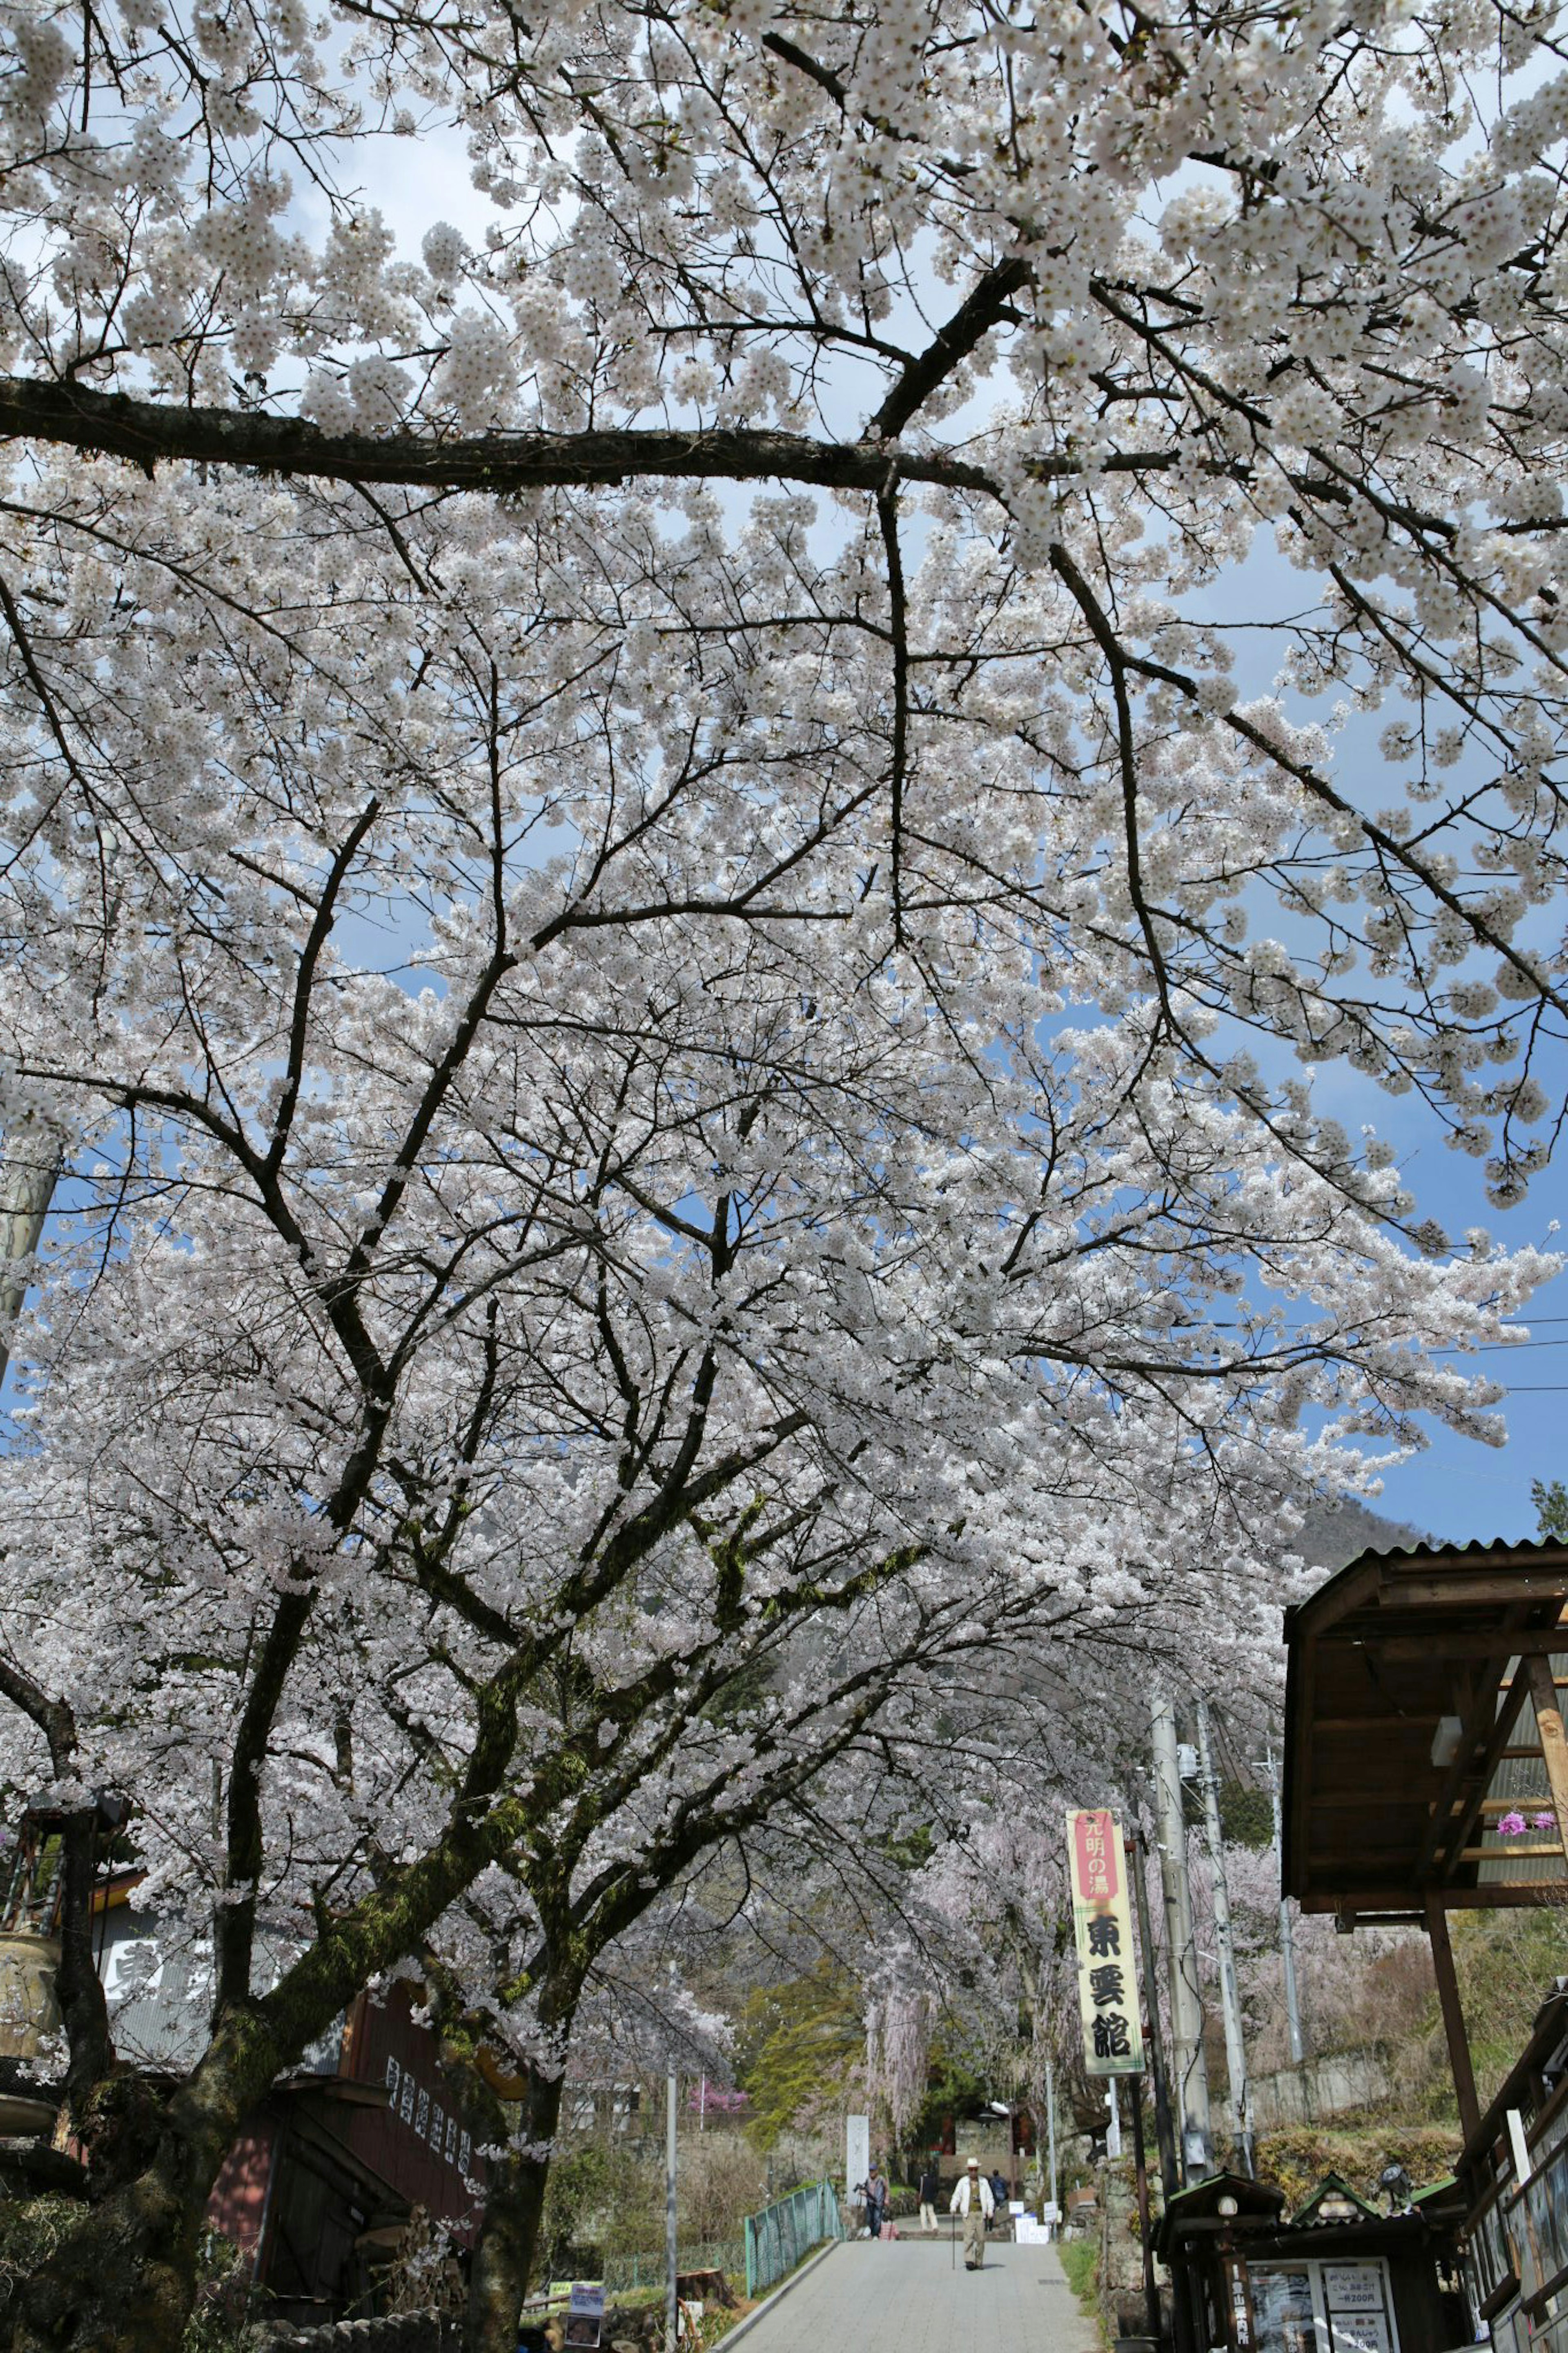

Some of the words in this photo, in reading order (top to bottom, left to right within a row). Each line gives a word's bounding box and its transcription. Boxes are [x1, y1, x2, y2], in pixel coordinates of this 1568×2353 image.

[1085, 1818, 1109, 1894] 光明の湯
[1087, 1916, 1131, 2059] 東雲館
